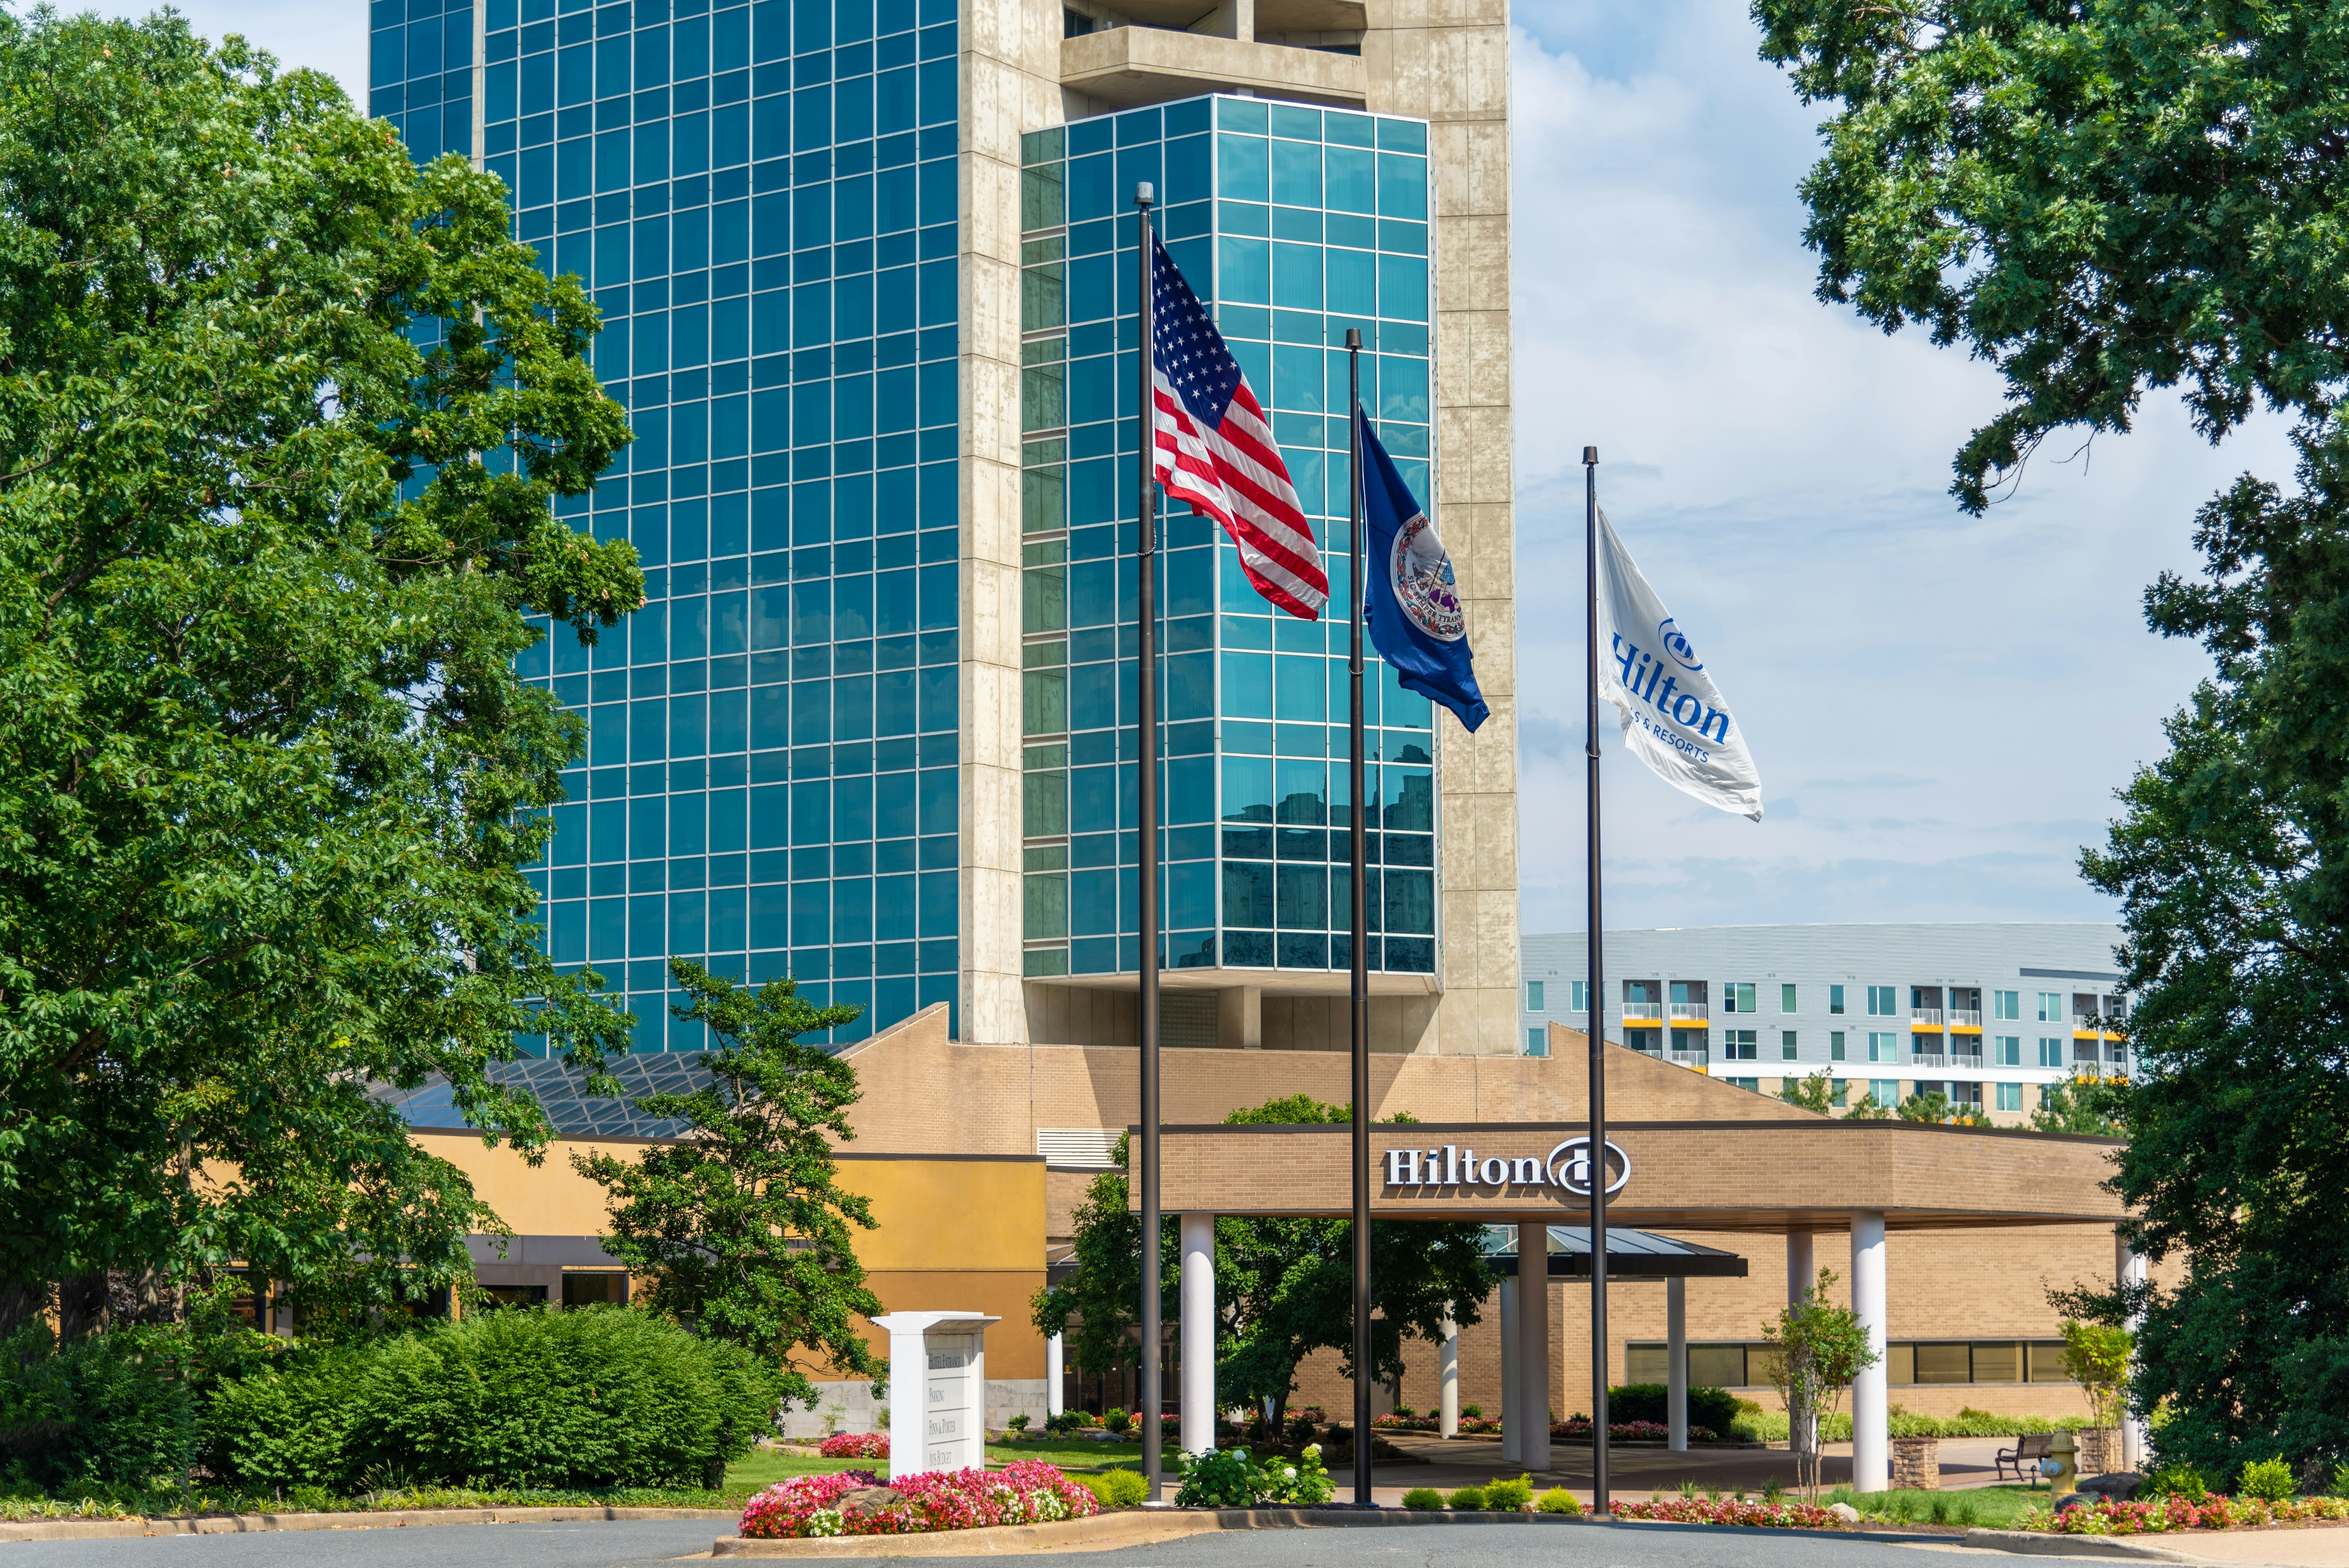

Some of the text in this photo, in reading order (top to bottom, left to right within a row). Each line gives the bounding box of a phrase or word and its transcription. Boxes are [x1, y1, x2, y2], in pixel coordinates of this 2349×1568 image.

[1408, 575, 1416, 590] SIC
[1413, 591, 1437, 619] SEMPER
[1613, 632, 1729, 744] Hilton
[1653, 724, 1709, 763] RESORTS
[1386, 1145, 1545, 1185] Hilton
